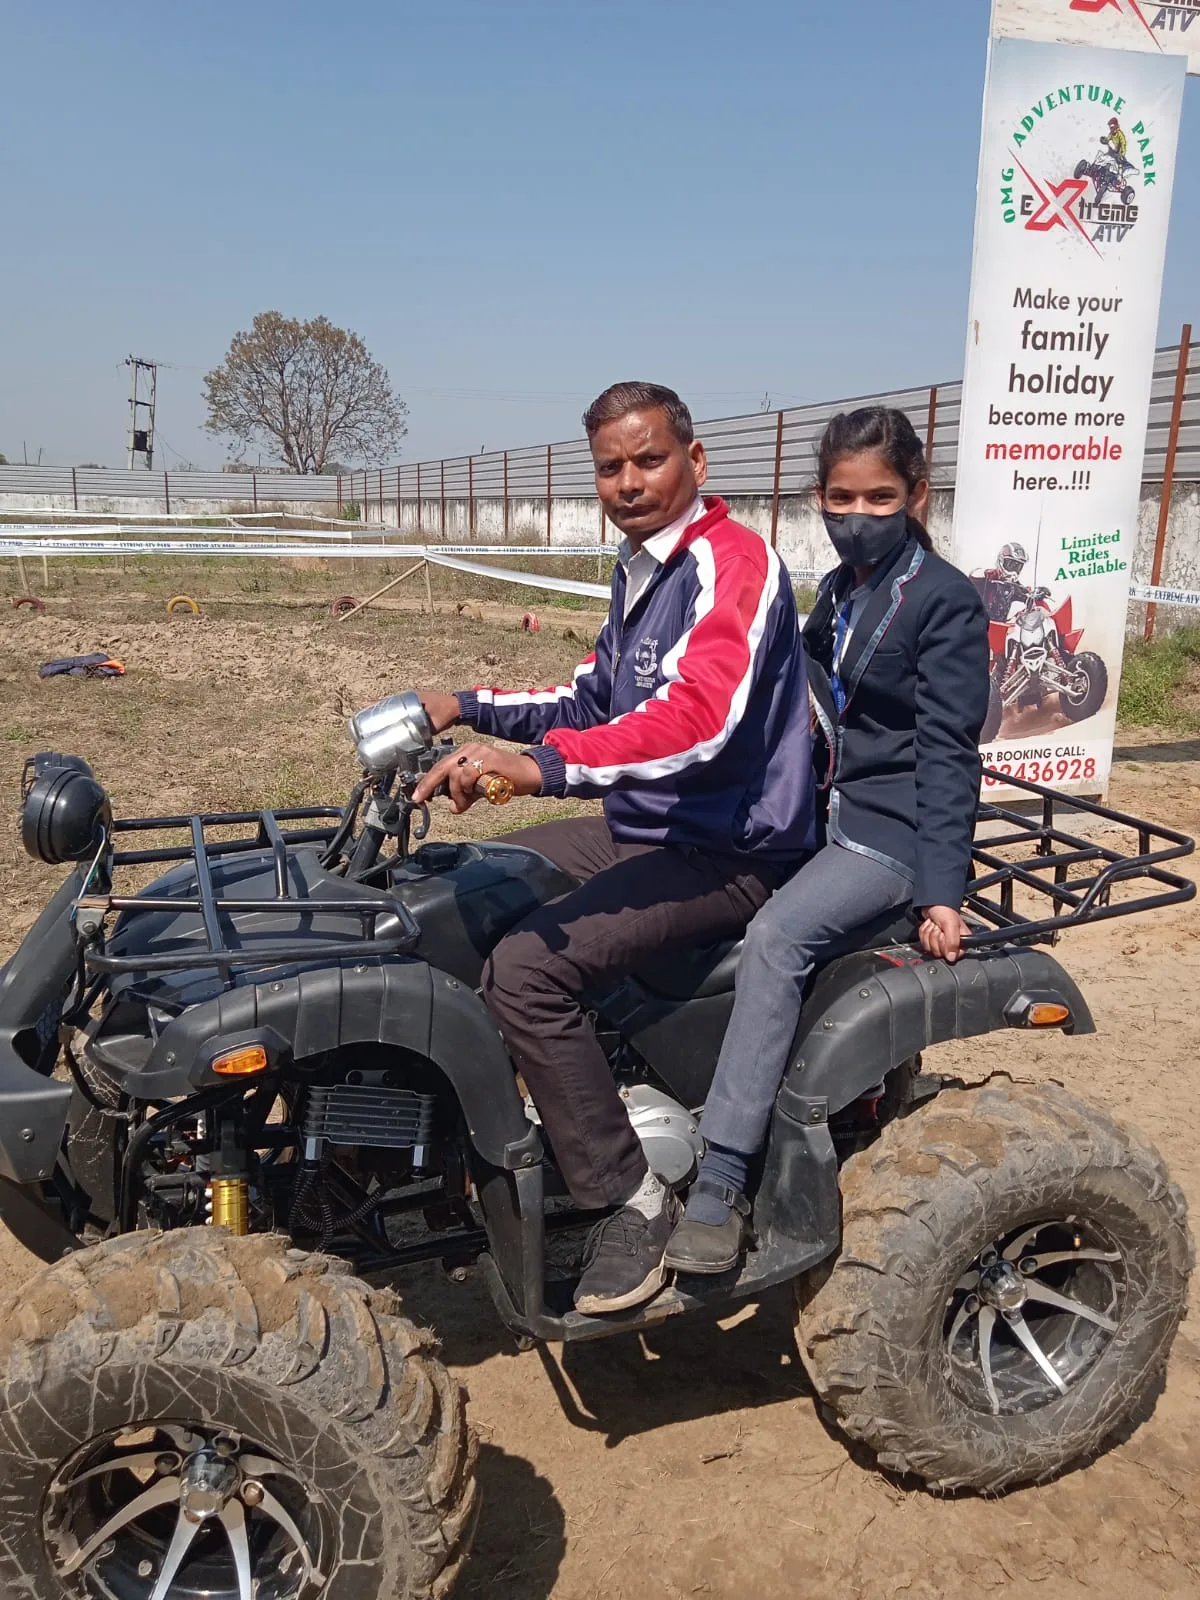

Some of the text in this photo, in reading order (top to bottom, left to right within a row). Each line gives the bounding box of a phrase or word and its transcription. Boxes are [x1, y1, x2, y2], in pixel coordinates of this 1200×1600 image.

[1150, 8, 1199, 32] ATV
[1000, 84, 1156, 224] OMG ADVENTURE PARK
[1092, 224, 1132, 243] ATV
[1013, 287, 1123, 316] Make your
[1021, 319, 1109, 360] family
[1008, 363, 1114, 402] holiday
[988, 404, 1125, 427] become more
[985, 436, 1122, 461] memorable
[1012, 470, 1091, 491] here..!!!
[1061, 529, 1121, 550] Limited
[1068, 548, 1109, 565] Rides
[1054, 558, 1127, 581] Available
[979, 745, 1086, 763] OR BOOKING CALL:
